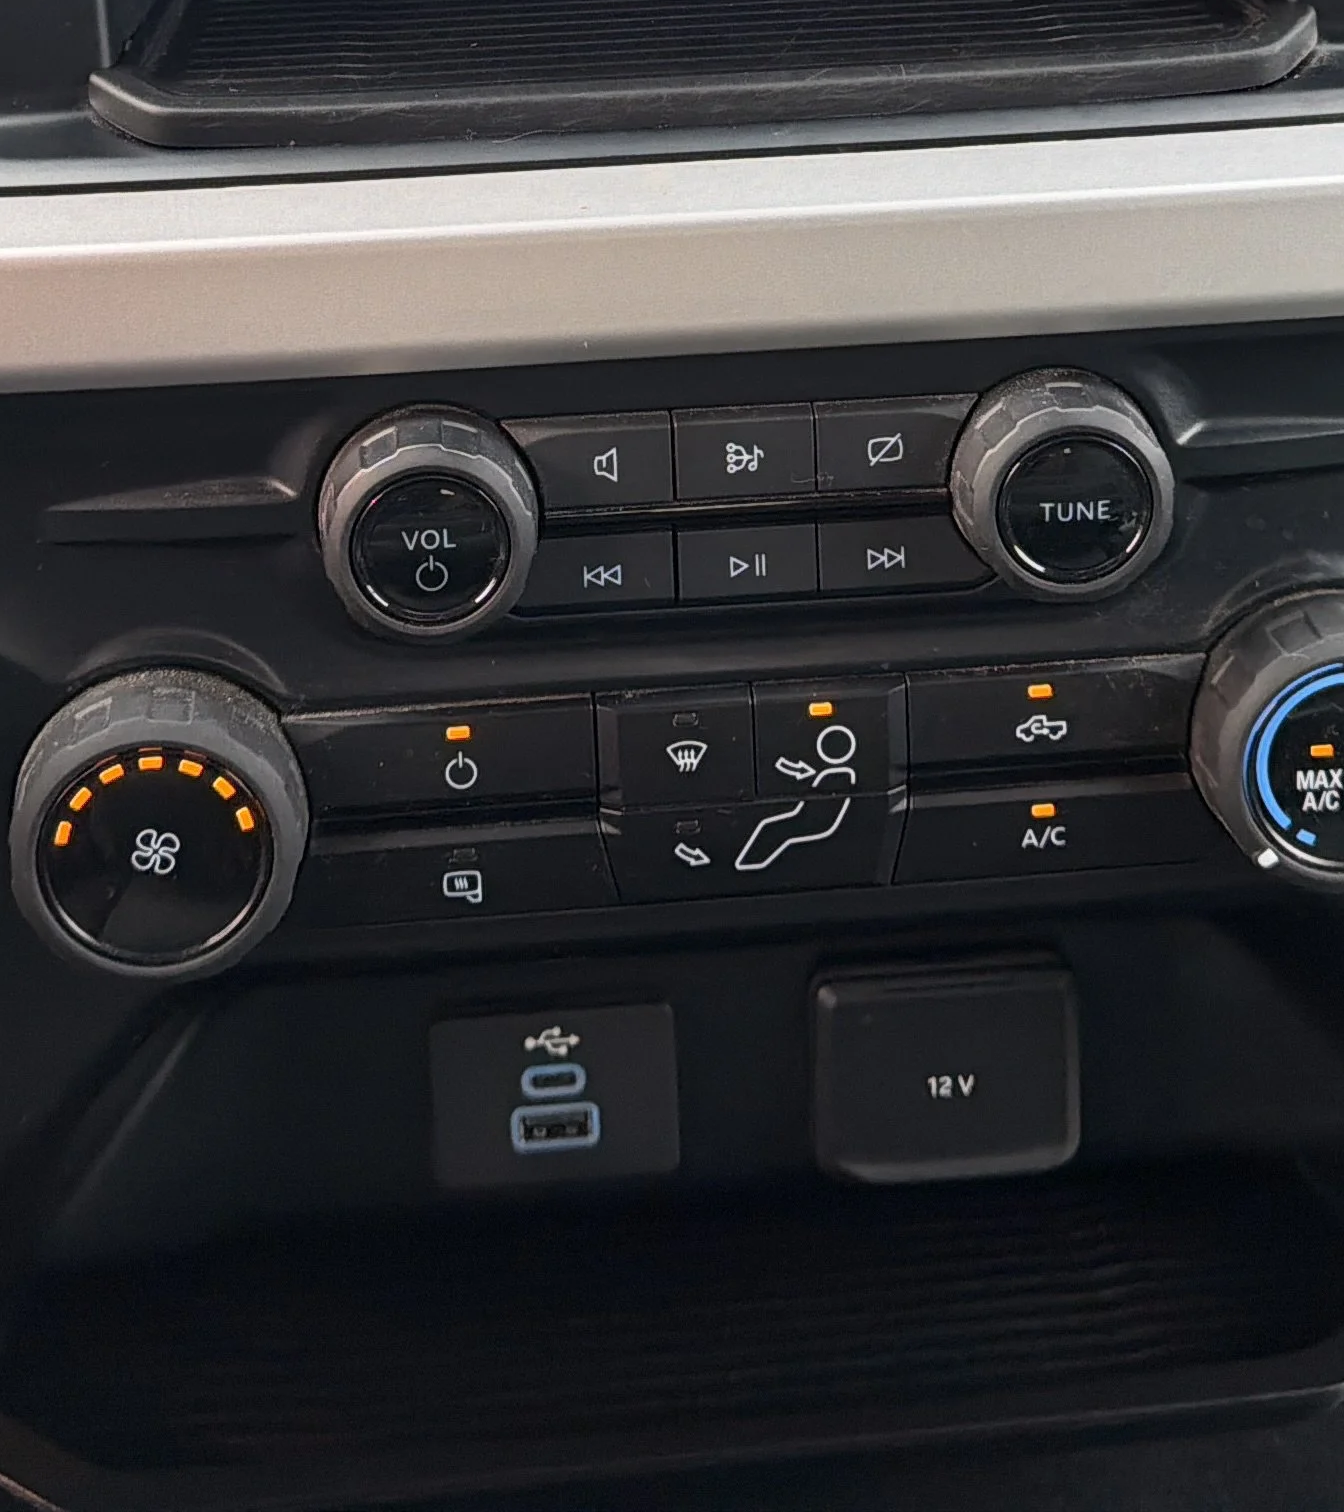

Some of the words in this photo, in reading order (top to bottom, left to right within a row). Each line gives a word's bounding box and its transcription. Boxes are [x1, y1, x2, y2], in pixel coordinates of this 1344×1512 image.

[1039, 498, 1112, 524] TUNE
[401, 529, 457, 553] VOL
[1296, 768, 1344, 791] MAX
[1301, 789, 1340, 812] A/C
[1021, 826, 1066, 849] A/C
[928, 1075, 953, 1099] 12
[957, 1074, 975, 1096] V
